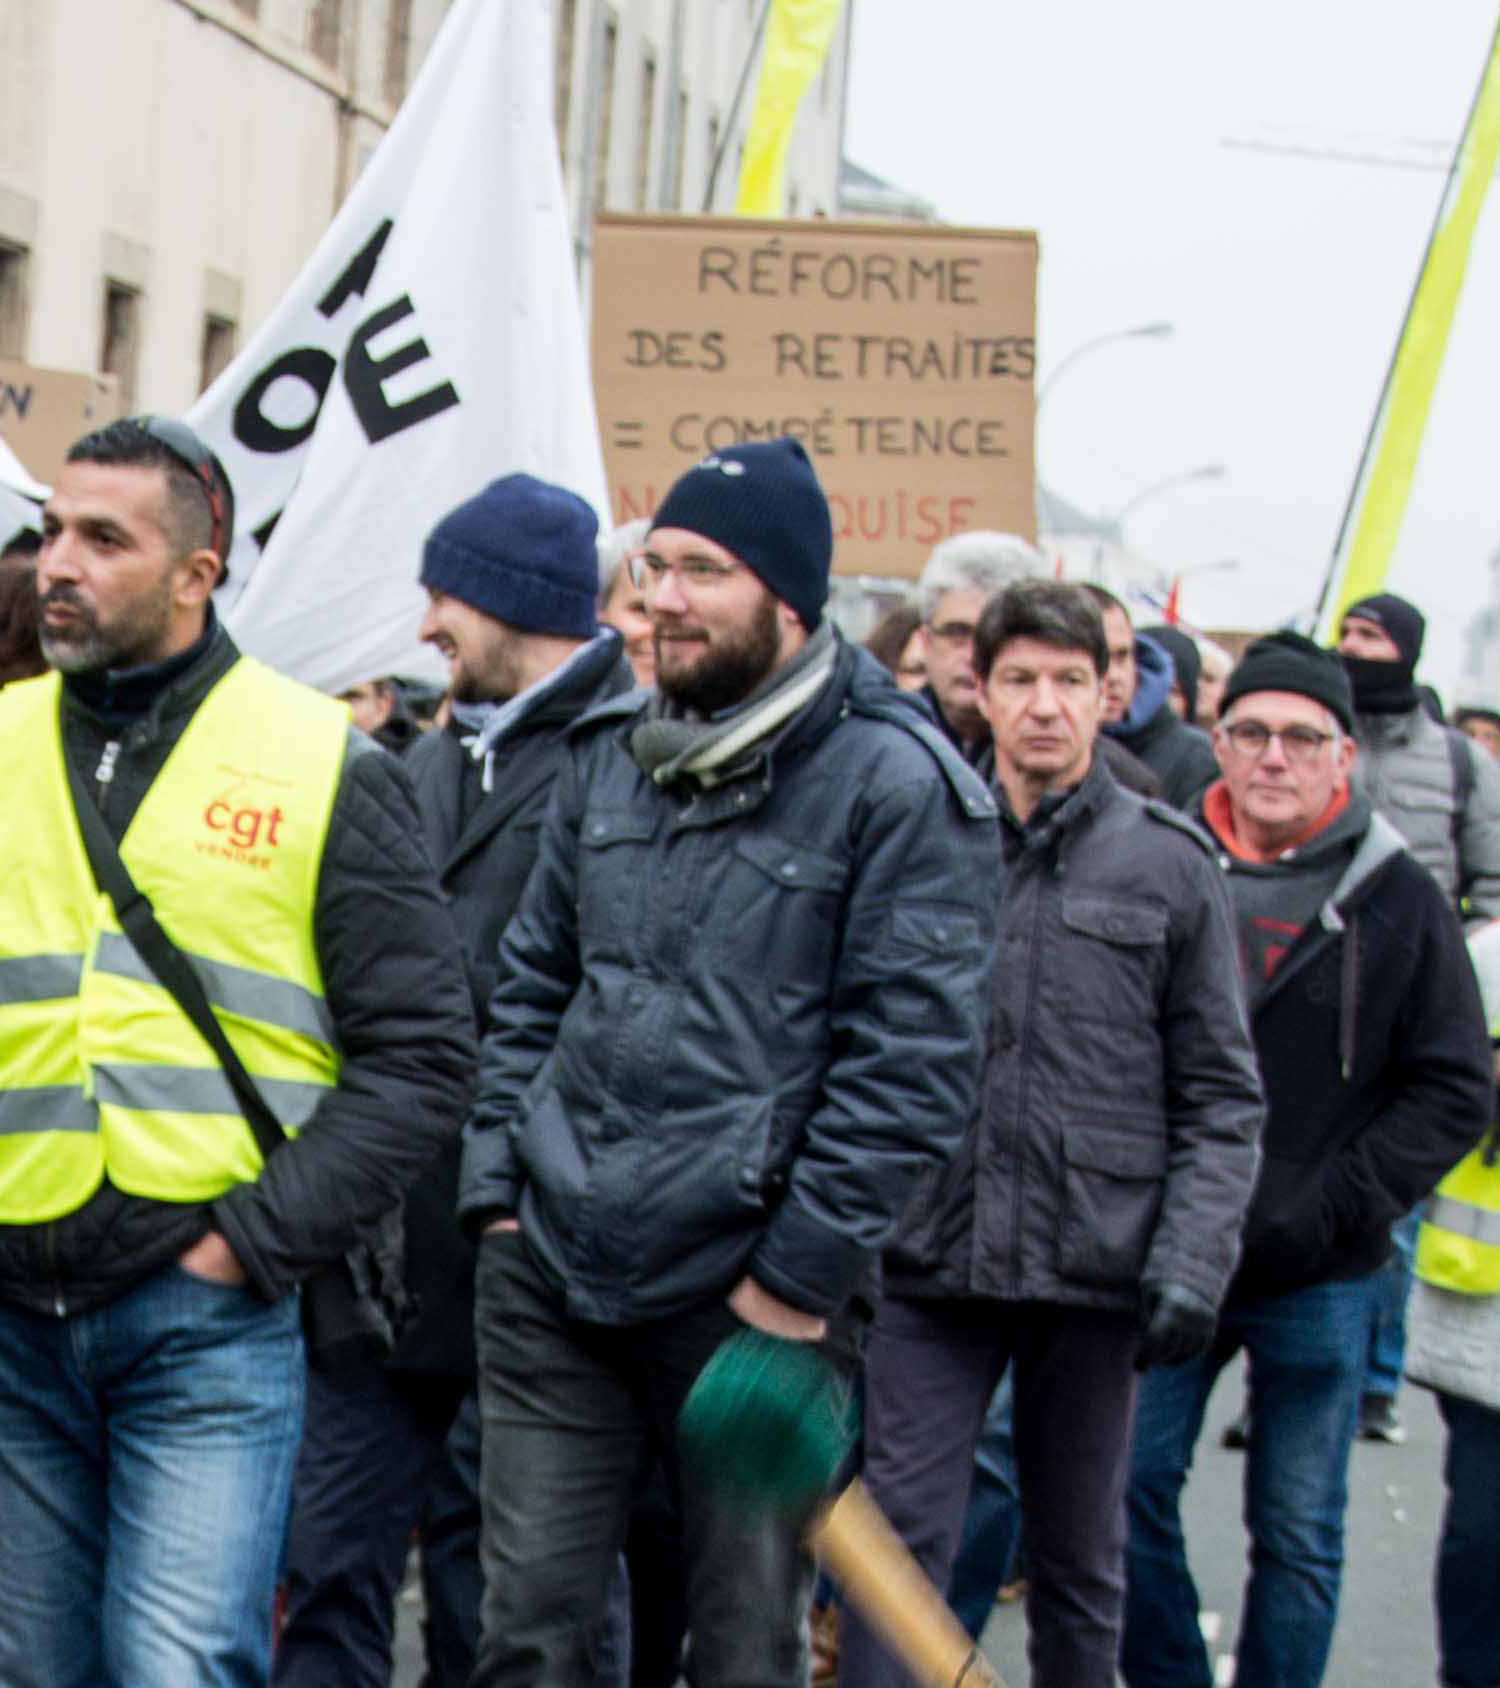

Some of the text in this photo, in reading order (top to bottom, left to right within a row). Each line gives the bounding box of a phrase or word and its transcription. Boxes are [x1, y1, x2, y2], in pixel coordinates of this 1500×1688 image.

[698, 239, 982, 305] RÉFORME
[625, 330, 727, 372] DES
[203, 800, 284, 849] cgt
